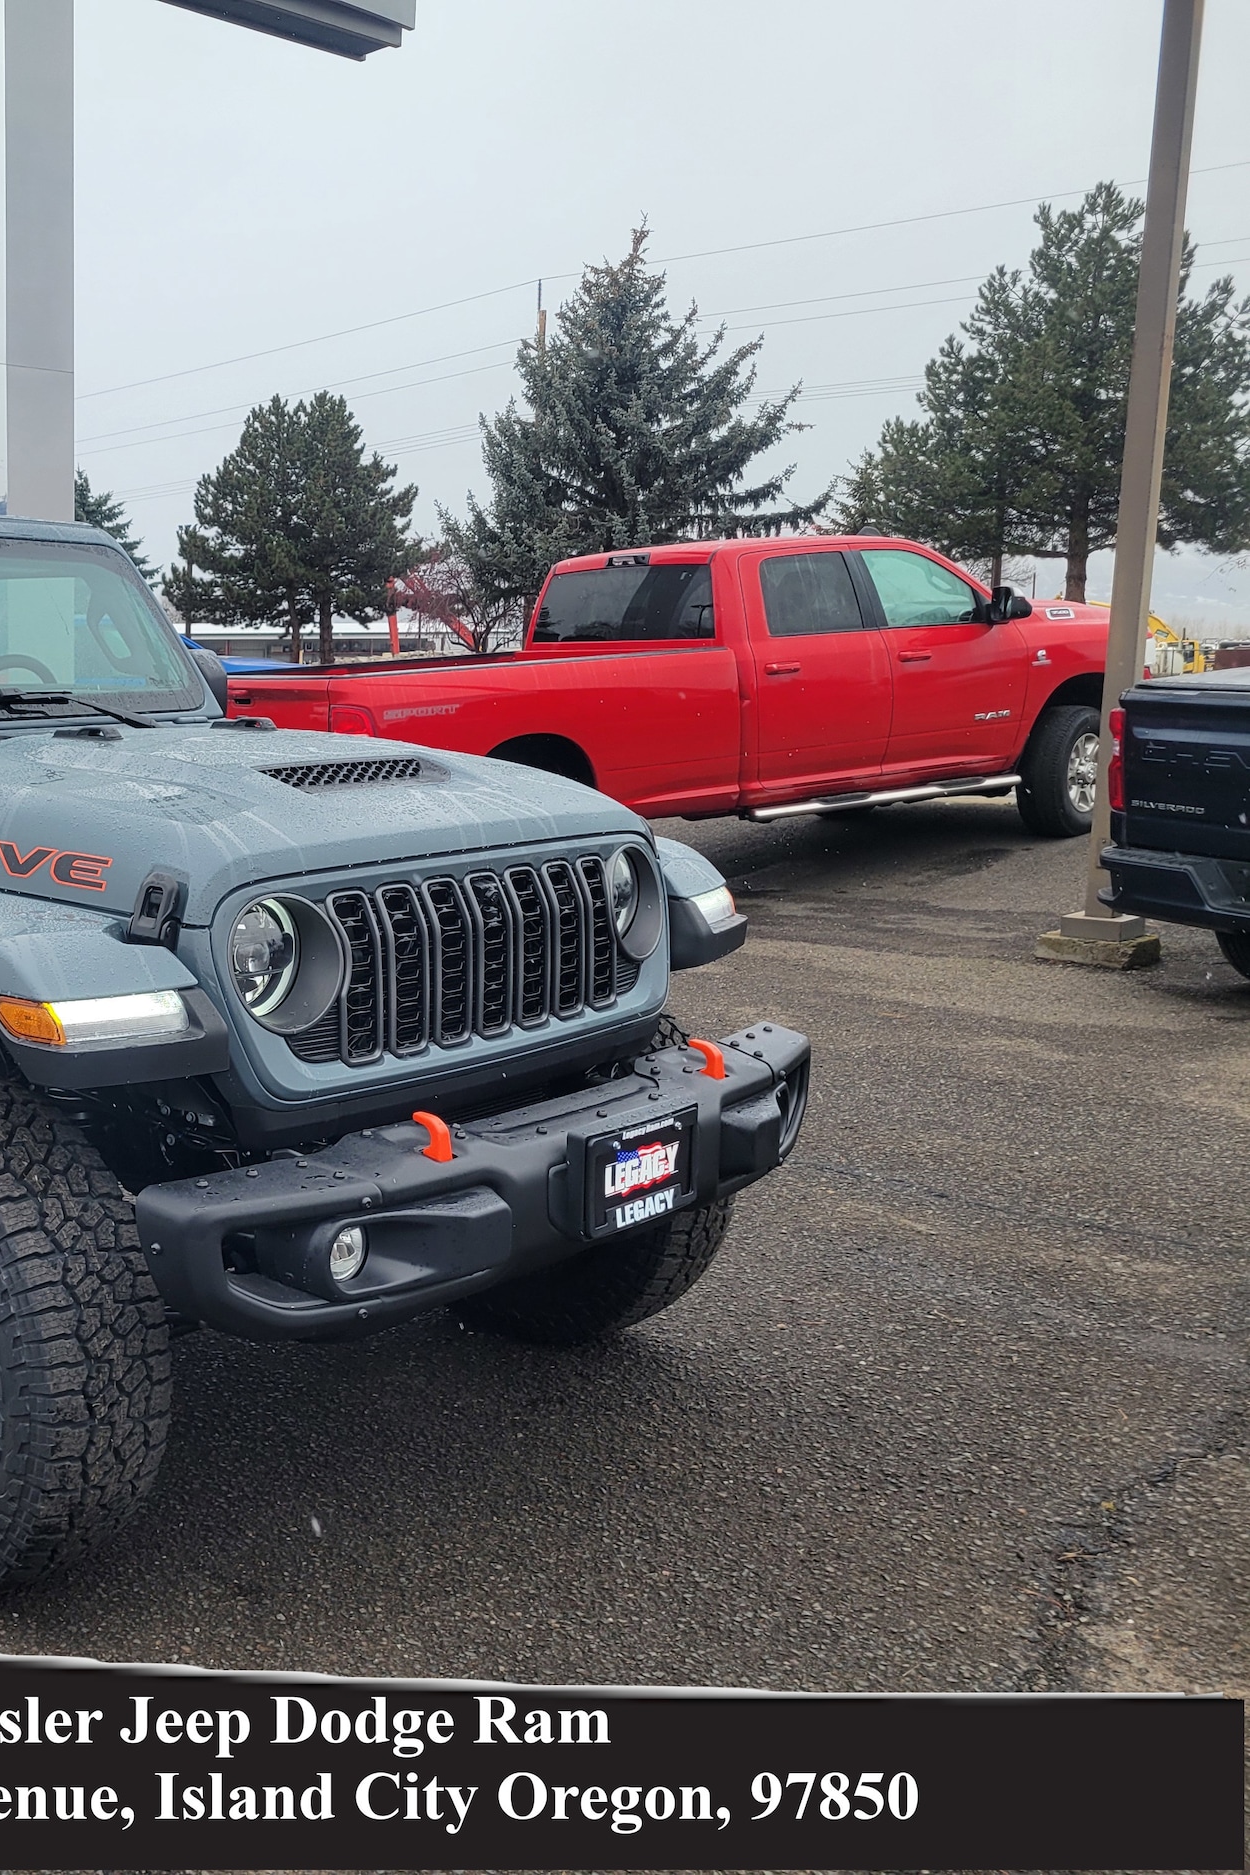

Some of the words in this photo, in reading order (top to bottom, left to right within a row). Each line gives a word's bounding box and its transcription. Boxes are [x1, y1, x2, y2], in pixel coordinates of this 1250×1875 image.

[383, 704, 460, 720] SPORT
[974, 709, 1011, 721] RAM
[1130, 799, 1206, 815] SILVERADO
[605, 1143, 679, 1196] LEGACY
[615, 1188, 675, 1228] LEGACY
